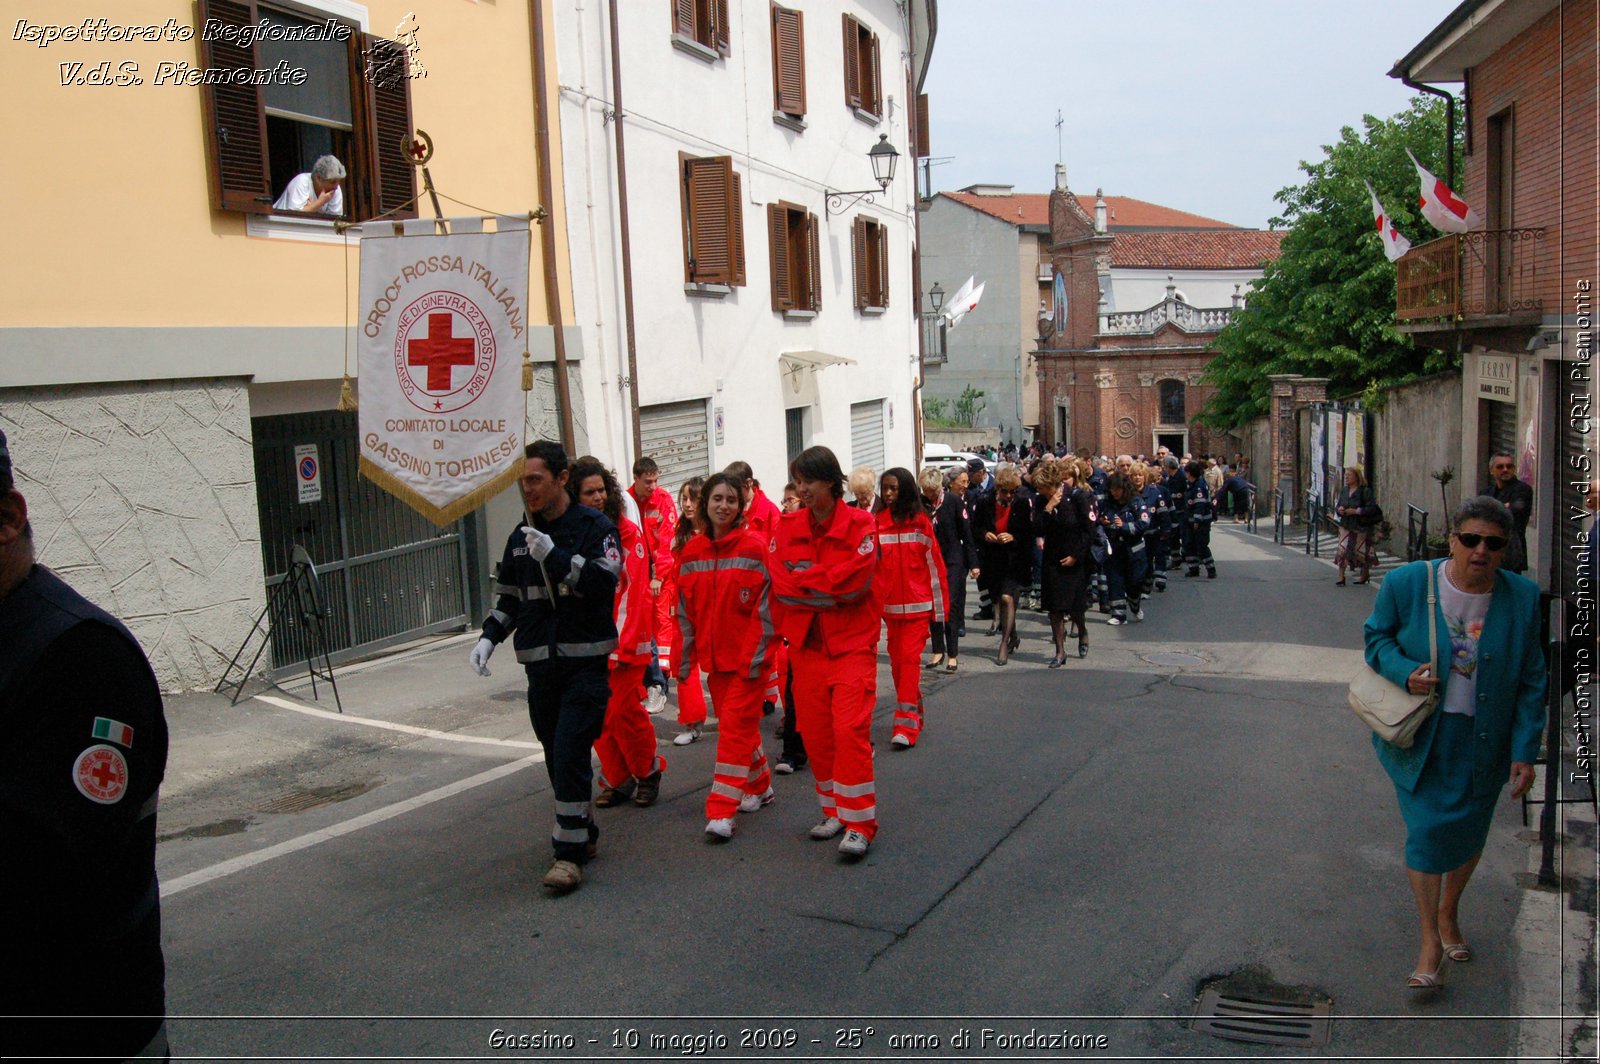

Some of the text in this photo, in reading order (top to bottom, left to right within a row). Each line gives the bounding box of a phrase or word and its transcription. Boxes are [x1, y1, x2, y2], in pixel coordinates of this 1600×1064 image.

[401, 255, 464, 283] ROSSA
[467, 260, 524, 340] ITALIANA
[421, 295, 467, 312] GINEVRA
[410, 304, 421, 318] DI
[466, 306, 480, 322] 22
[476, 320, 493, 372] AGOSTO
[1481, 361, 1511, 379] TERRY
[467, 373, 486, 396] 1864
[1494, 386, 1510, 396] STYLE
[385, 419, 506, 433] COMITATO LOCALE
[433, 439, 444, 450] DI
[364, 432, 519, 477] GASSINO TORINESE
